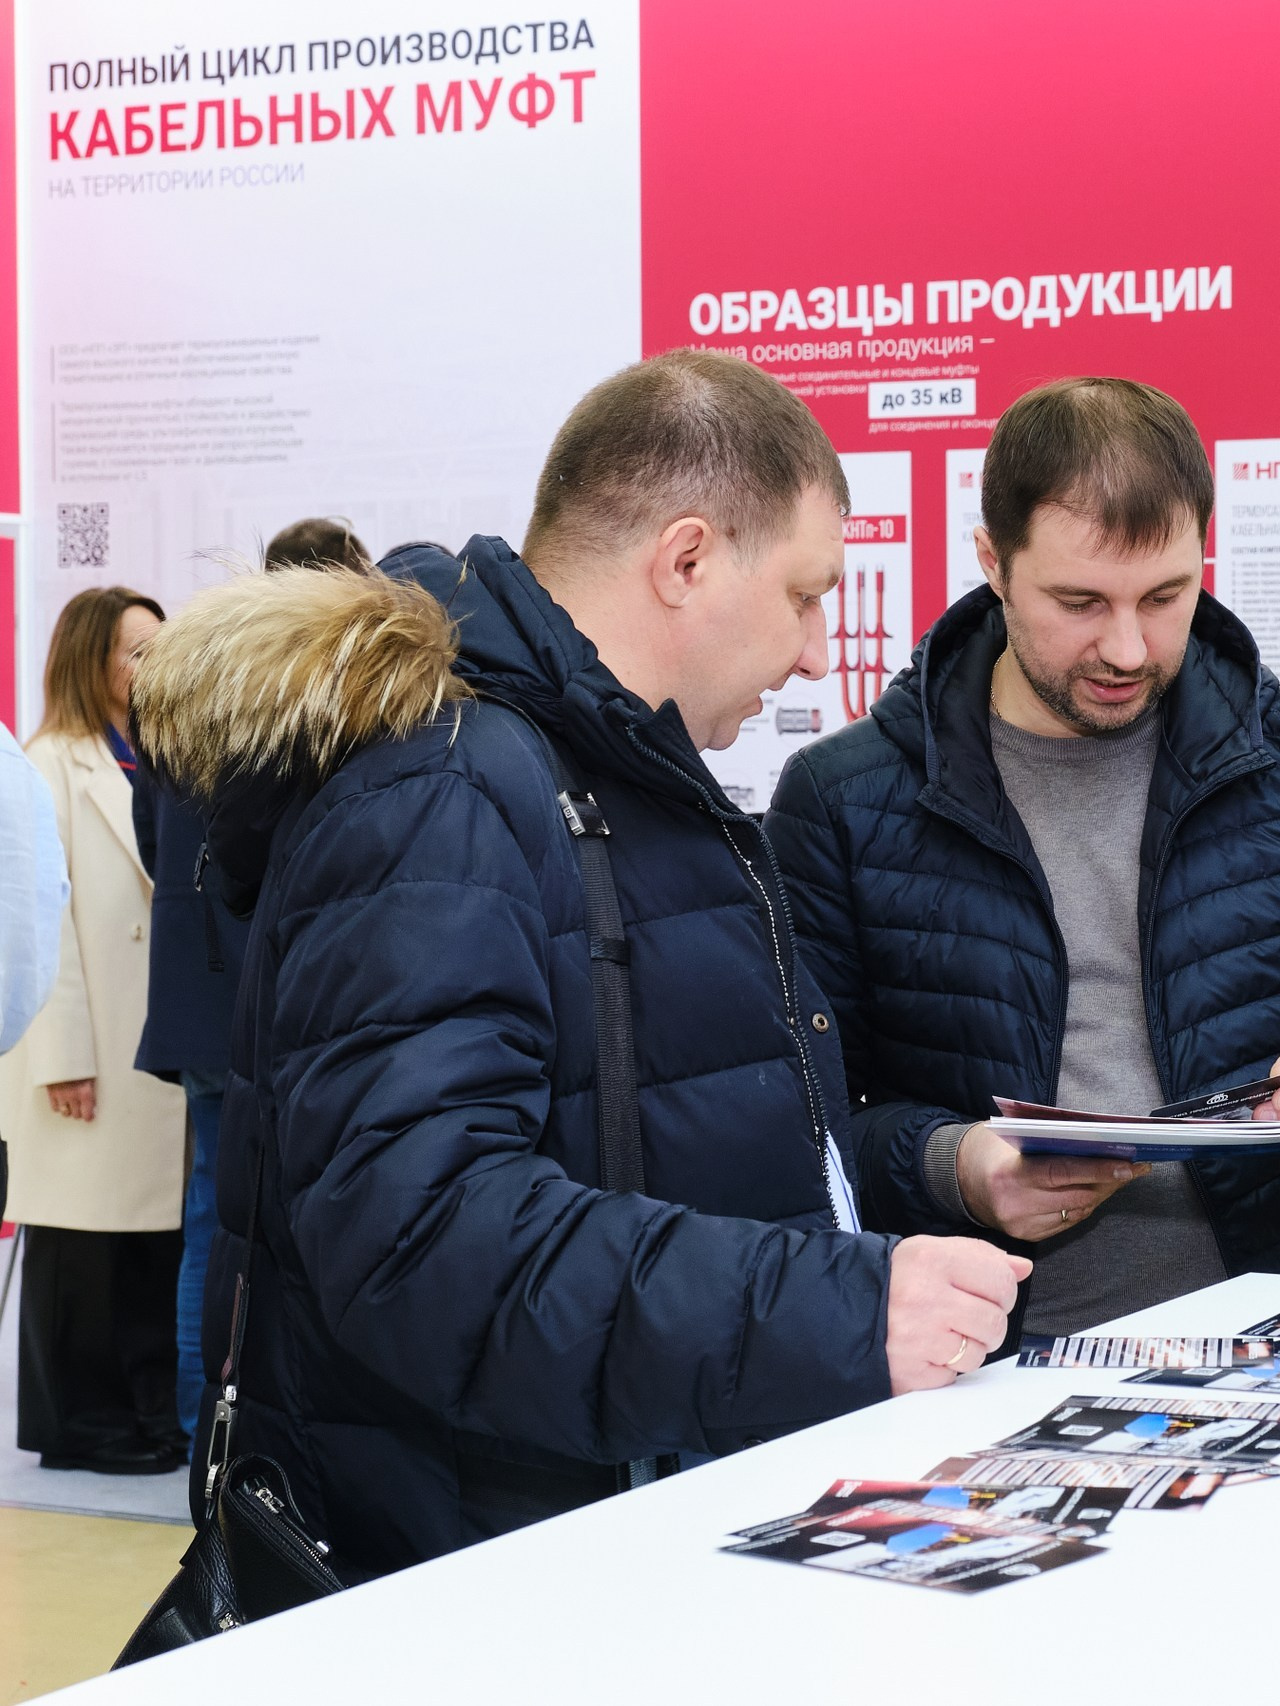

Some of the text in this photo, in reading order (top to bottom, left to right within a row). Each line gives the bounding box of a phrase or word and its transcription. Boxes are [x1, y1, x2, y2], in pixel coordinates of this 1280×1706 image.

[48, 18, 596, 92] ПОЛНЫЙ ЦИКЛ ПРОИЗВОДСТВА
[48, 69, 598, 162] КАБЕЛЬНЫХ МУФТ
[48, 163, 305, 200] НА ТЕРРИТОРИИ РОССИИ
[689, 265, 1232, 336] ОБРАЗЦЫ ПРОДУКЦИИ
[752, 340, 852, 363] основная
[858, 335, 974, 362] продукция
[943, 363, 981, 378] муфты
[882, 388, 962, 411] до 35 кВ
